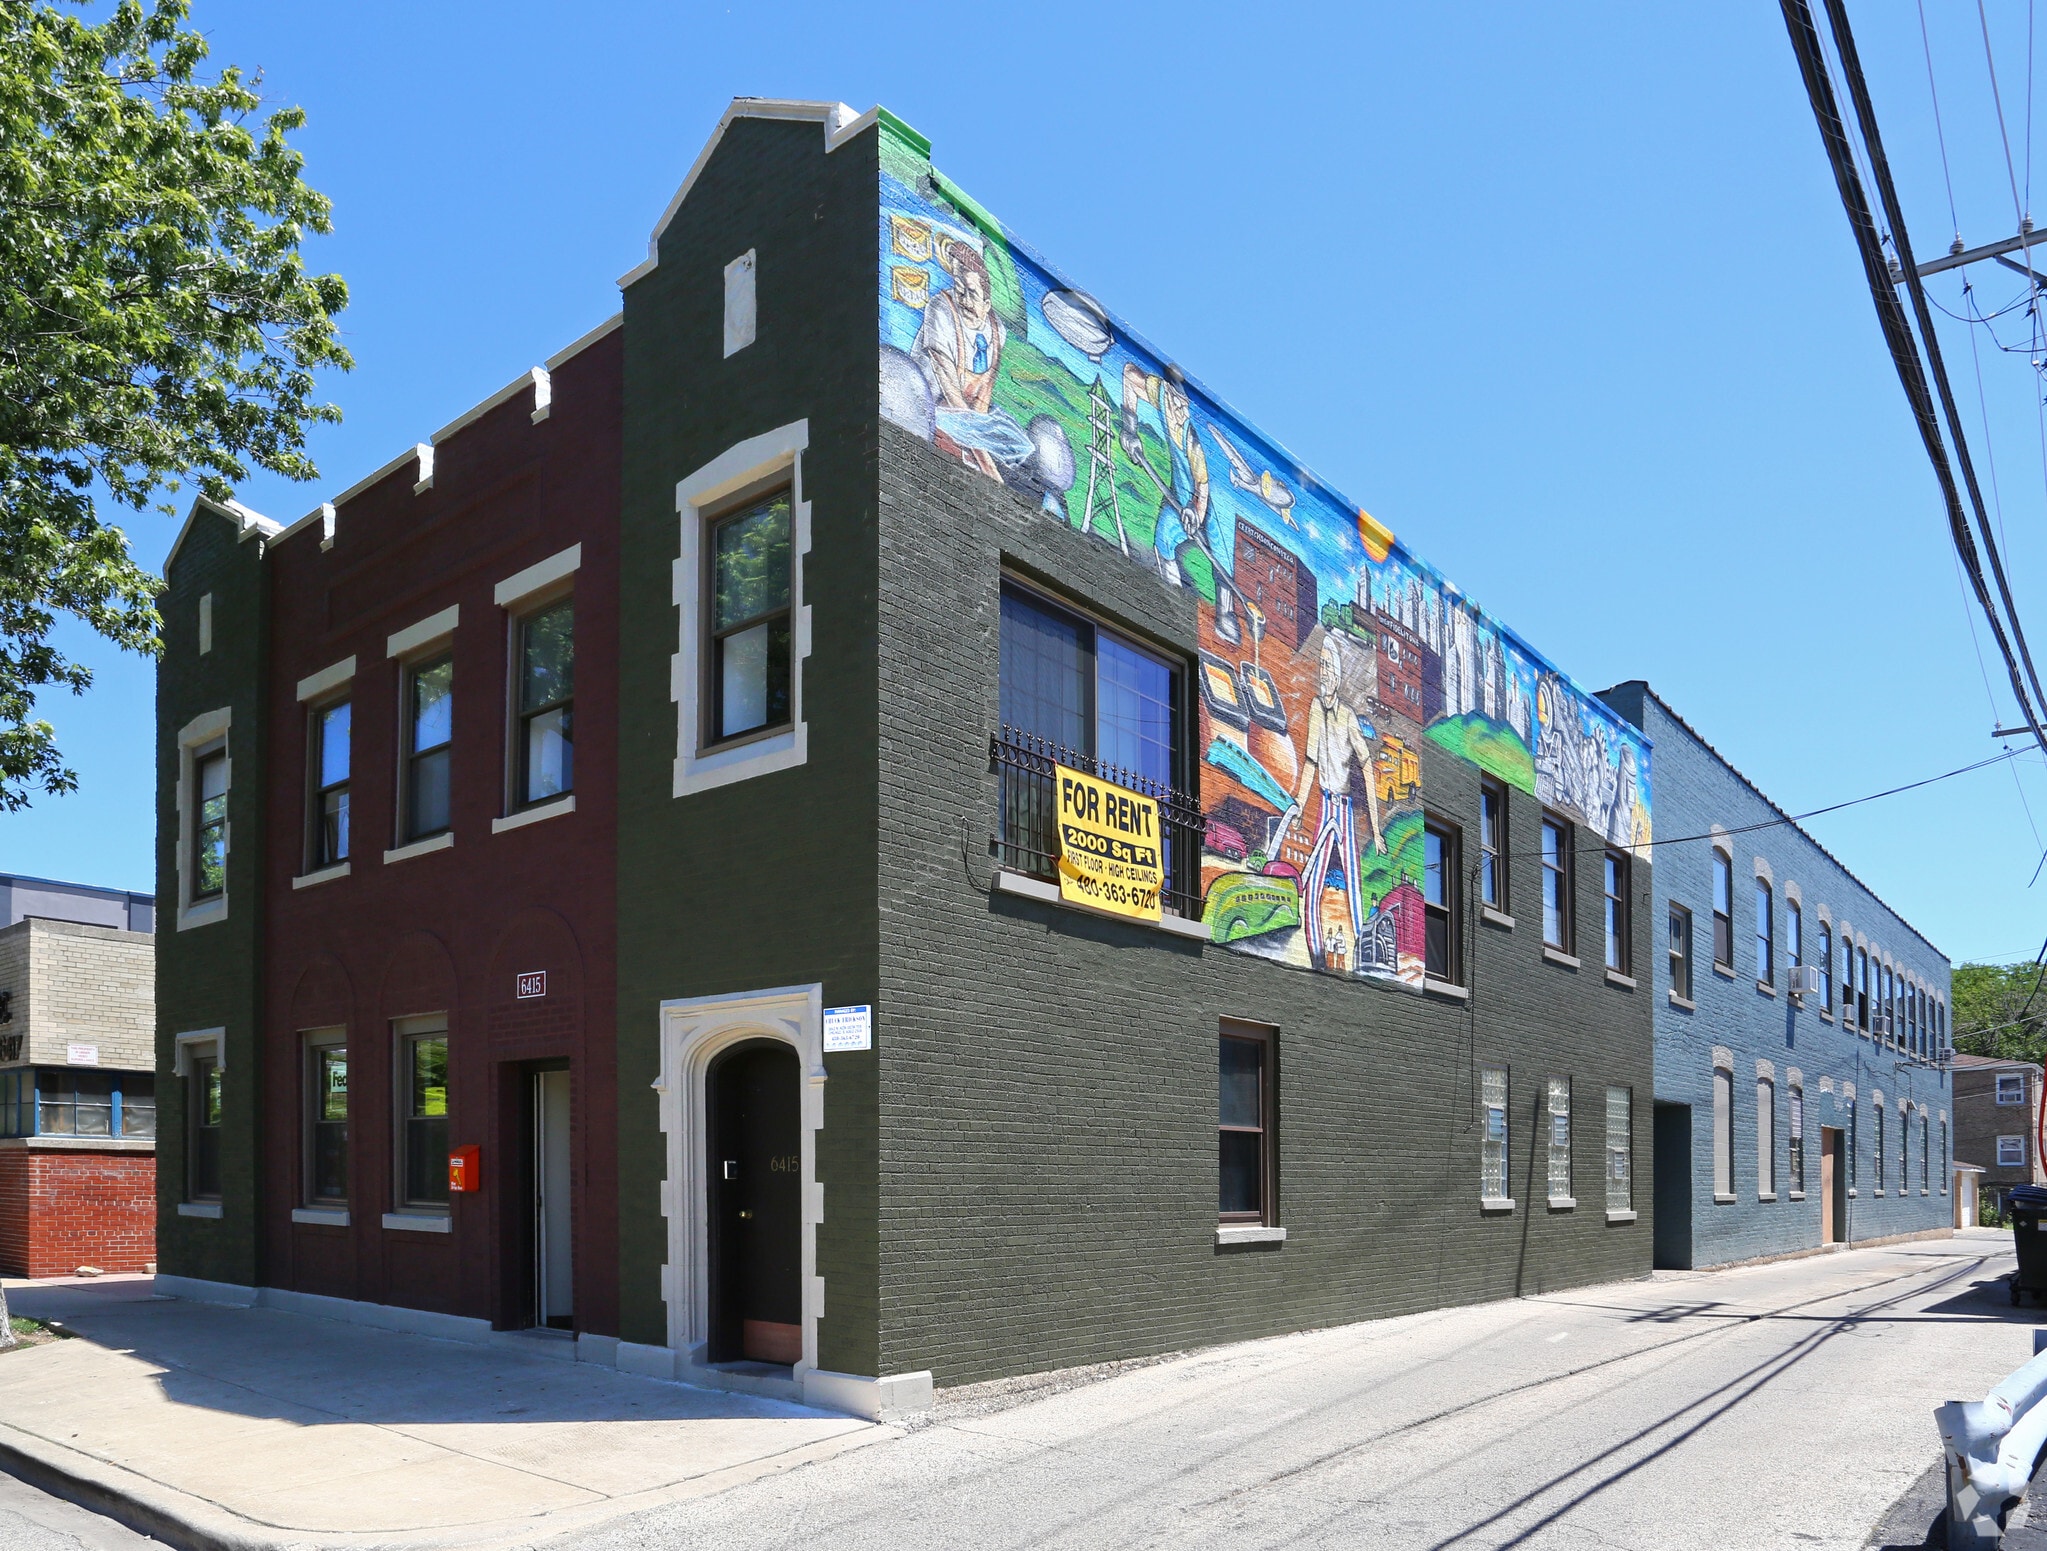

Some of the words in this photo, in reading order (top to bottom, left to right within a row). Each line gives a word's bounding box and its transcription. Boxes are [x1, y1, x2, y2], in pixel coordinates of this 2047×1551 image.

[1062, 777, 1100, 824] FOR
[1105, 792, 1152, 838] RENT
[1067, 828, 1108, 854] 2000
[1111, 841, 1132, 864] Sq
[1134, 847, 1153, 864] Ft
[1067, 849, 1083, 867] FIRST
[1084, 853, 1104, 874] FLOOR
[1108, 862, 1125, 879] HIGH
[1126, 867, 1158, 885] CEILINGS
[1076, 874, 1156, 910] 480-363-6720
[521, 977, 541, 995] 6415
[770, 1156, 800, 1172] 6415
